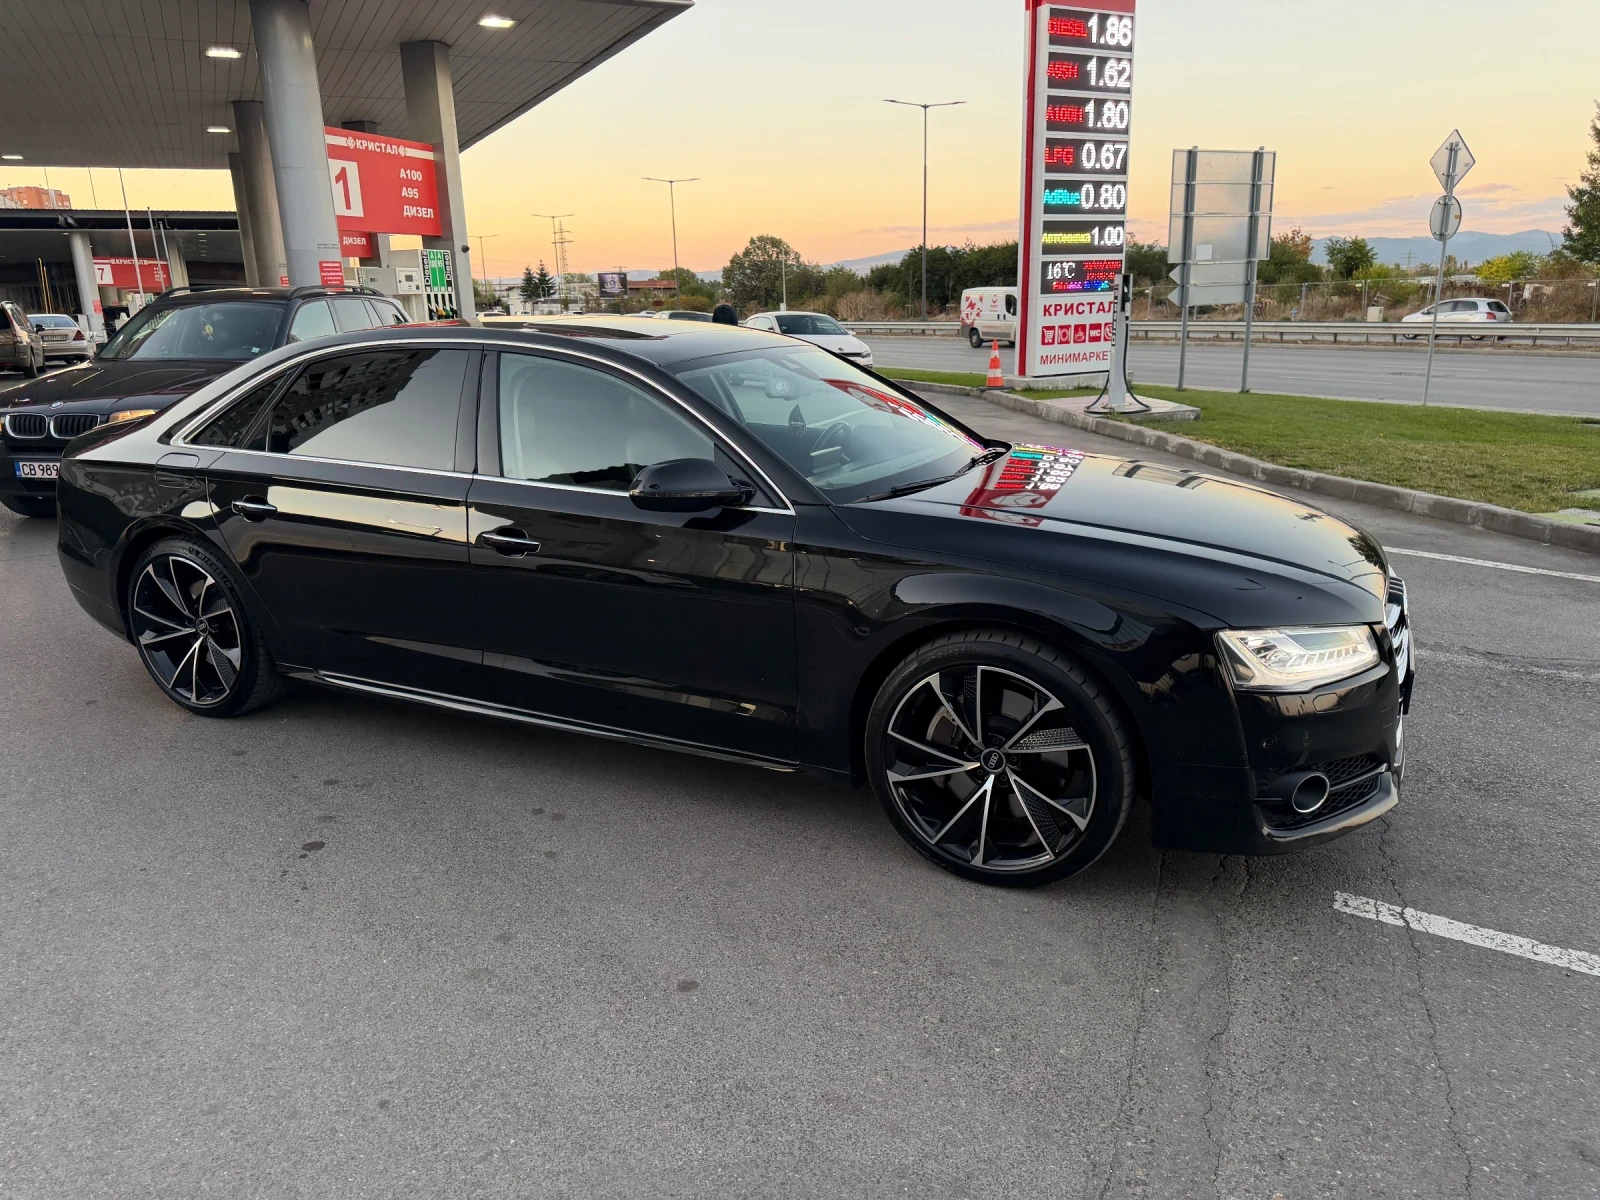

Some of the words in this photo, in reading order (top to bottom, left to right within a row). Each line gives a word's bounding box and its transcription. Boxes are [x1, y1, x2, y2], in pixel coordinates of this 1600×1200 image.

[1087, 13, 1132, 46] 1.86
[1086, 56, 1130, 87] 1.62
[1084, 99, 1129, 128] 1.80
[356, 138, 399, 155] КРИСТАЛ
[1044, 146, 1074, 165] LPG
[1081, 141, 1127, 169] 0.67
[334, 166, 352, 210] 1
[1042, 188, 1080, 205] AdBlue
[1081, 183, 1126, 209] 0.80
[403, 205, 434, 218] ДИЗЕЛ
[342, 236, 367, 246] ДИЗЕЛ
[1091, 226, 1123, 246] 1.00
[97, 267, 104, 281] 7
[1089, 329, 1101, 337] WC
[1040, 351, 1112, 366] МИНИМАРКЕ
[21, 463, 36, 476] CB
[38, 464, 59, 476] 989
